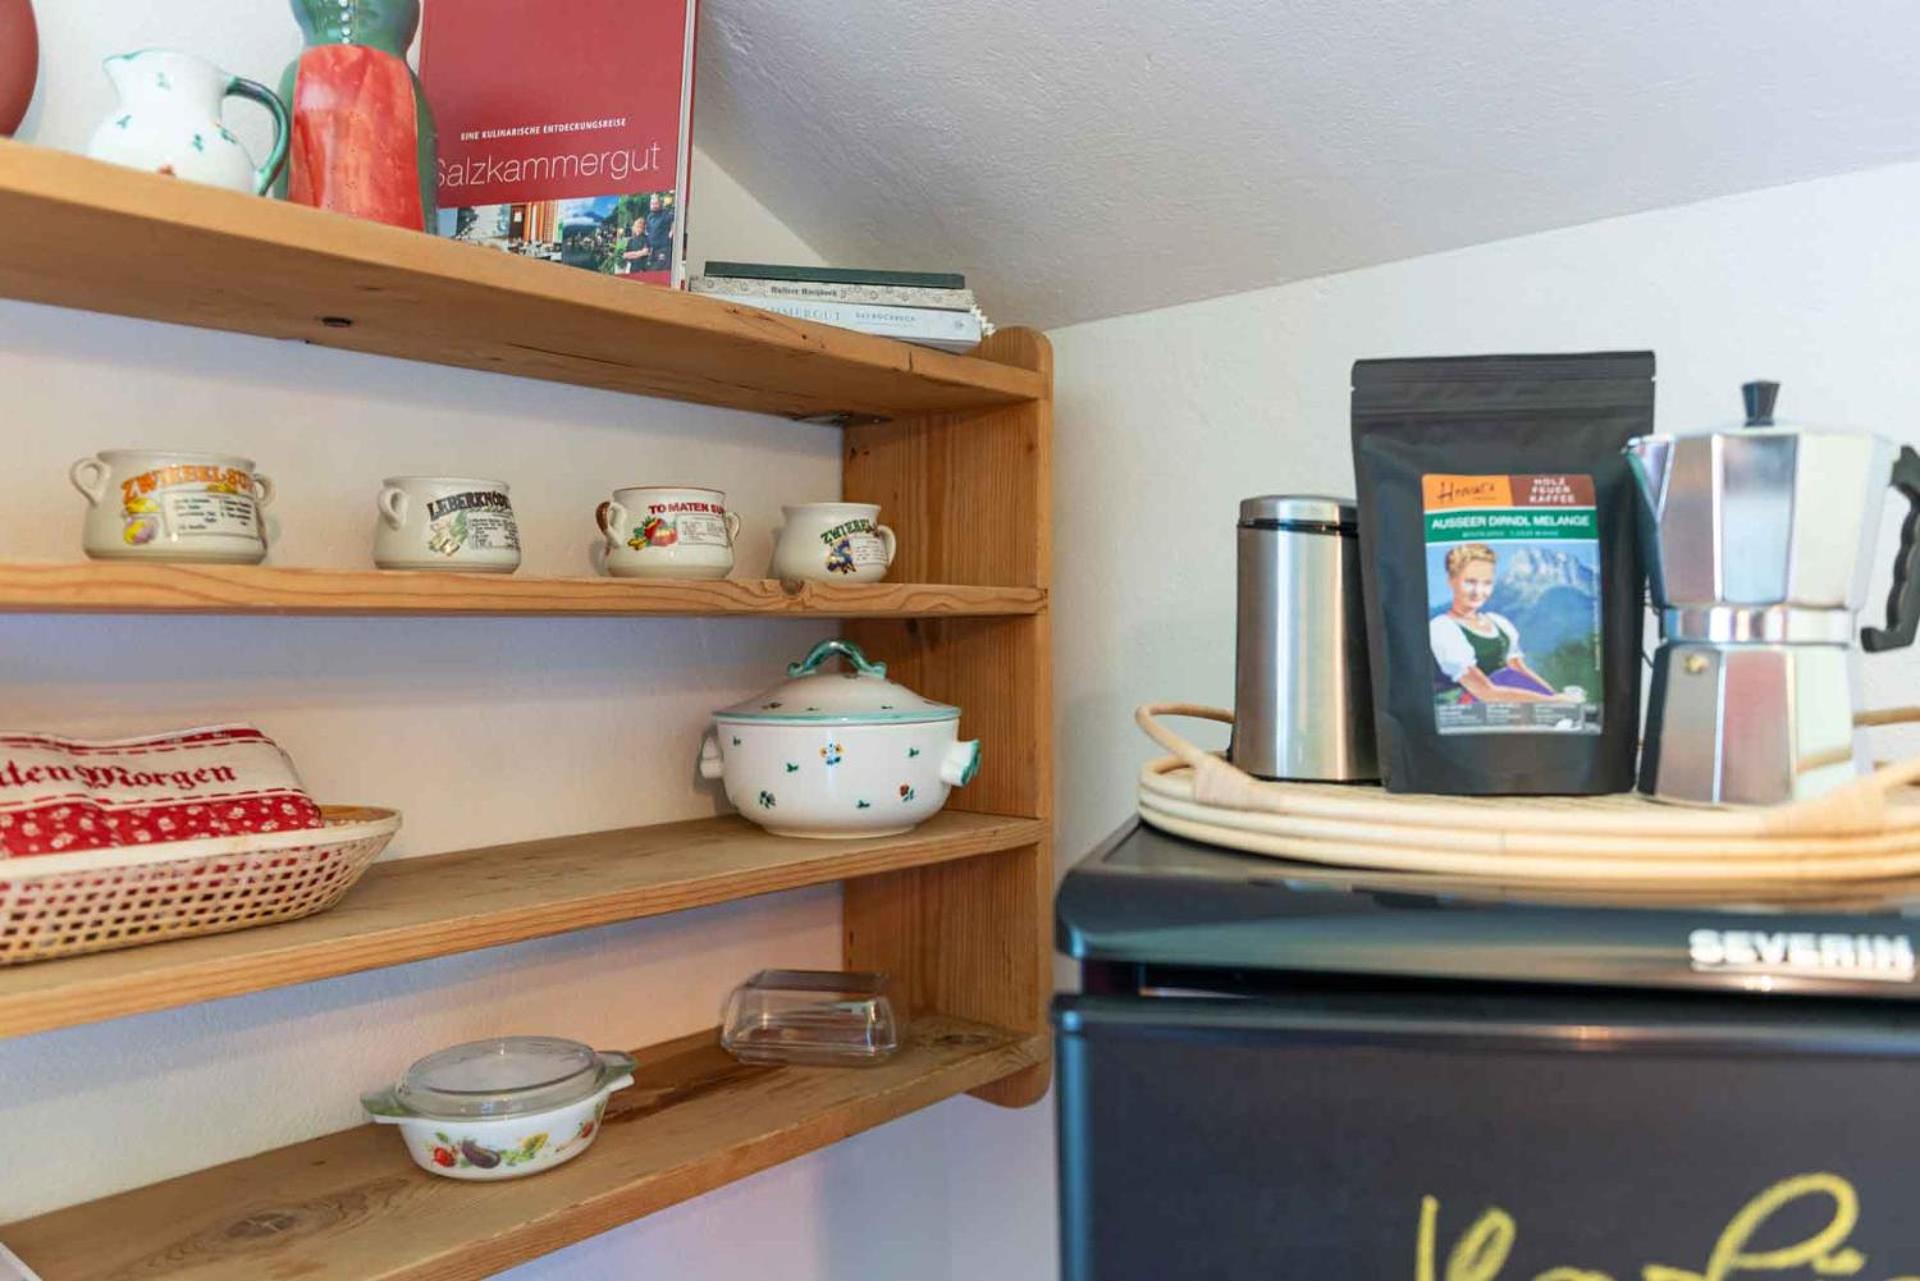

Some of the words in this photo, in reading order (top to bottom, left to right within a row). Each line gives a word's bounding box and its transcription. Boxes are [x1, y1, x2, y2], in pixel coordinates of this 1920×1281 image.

[460, 131, 480, 141] EINE
[482, 125, 541, 139] KULINARISCHE
[543, 117, 627, 135] ENTDECKUNGSREISE
[1529, 494, 1576, 504] KAFFEE
[1531, 486, 1571, 494] FEUER
[1431, 516, 1487, 530] AUSSEER
[1488, 516, 1532, 528] DIRNDL
[1533, 515, 1591, 527] MELANGE
[73, 764, 237, 790] Morgen
[1689, 928, 1915, 981] SEVERIN
